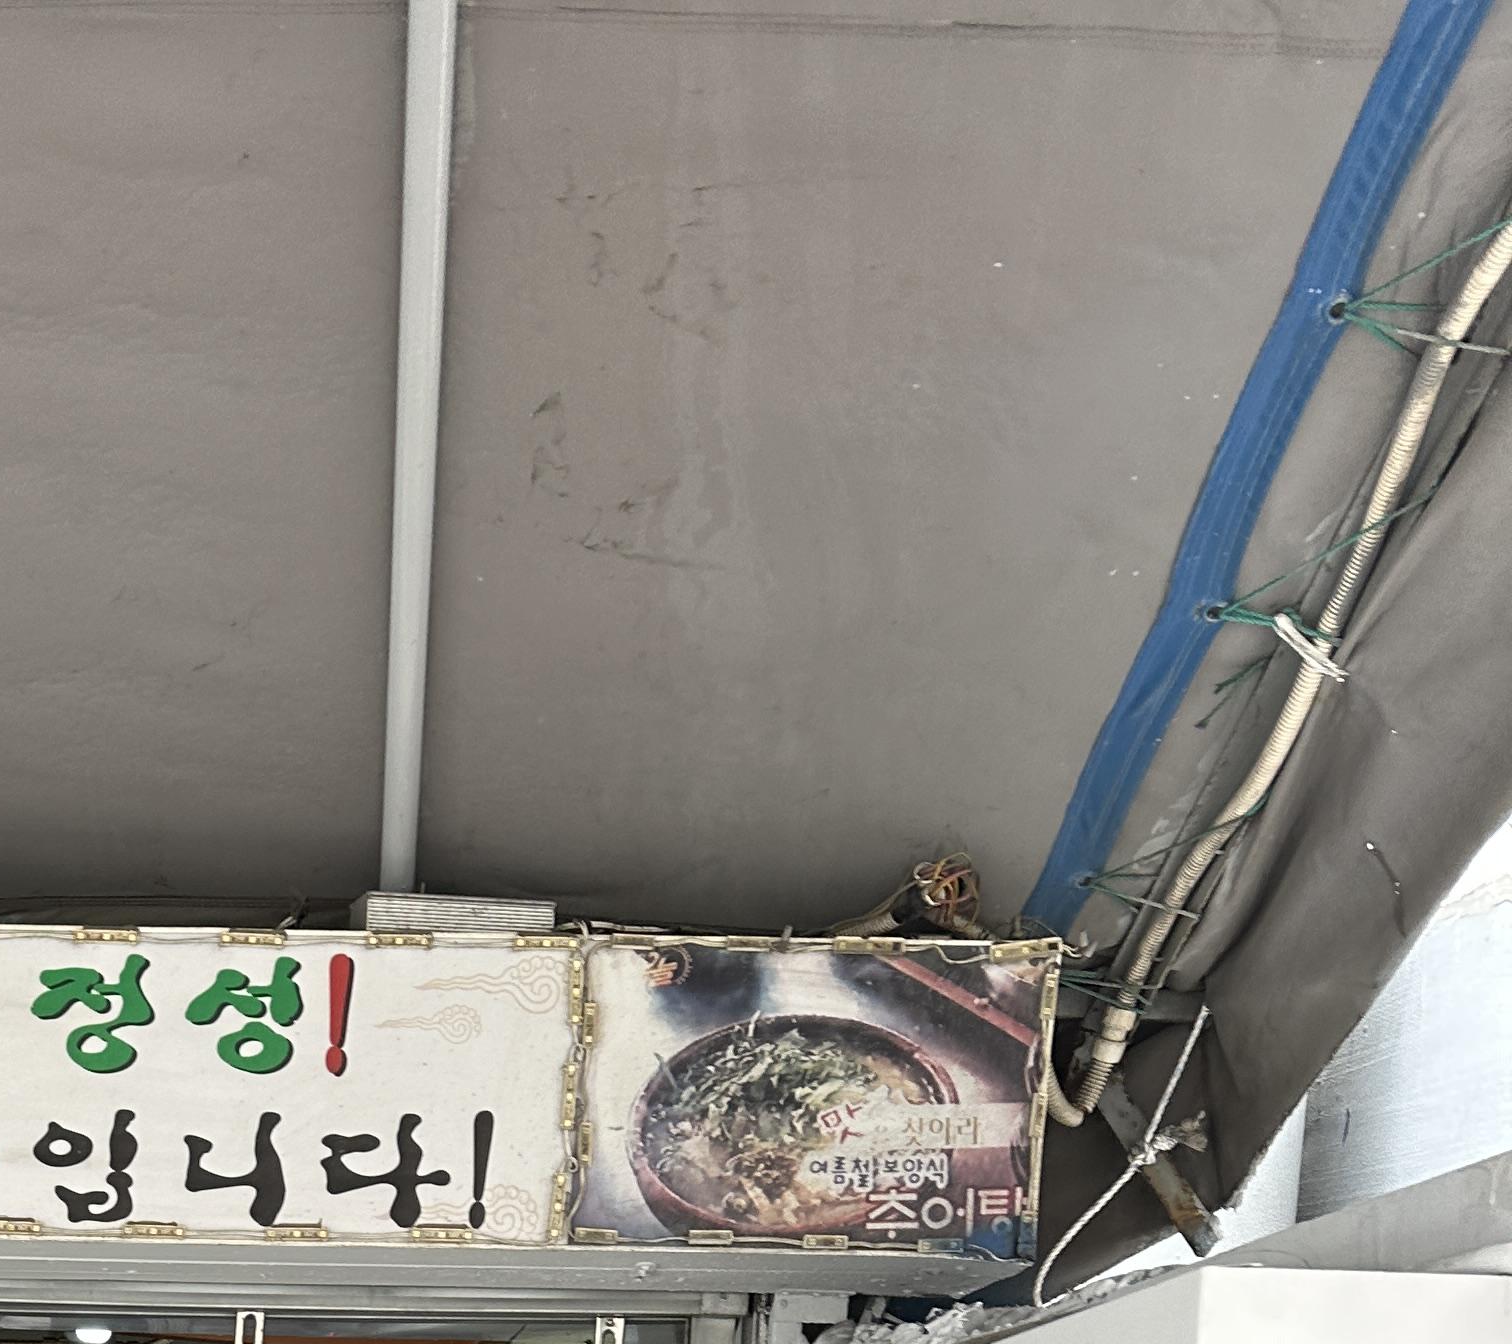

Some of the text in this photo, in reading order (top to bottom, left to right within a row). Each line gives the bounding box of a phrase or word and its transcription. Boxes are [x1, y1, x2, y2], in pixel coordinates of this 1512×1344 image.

[30, 953, 357, 1077] 정성!
[809, 1157, 873, 1188] 여름철
[864, 1187, 1028, 1241] 추어탕
